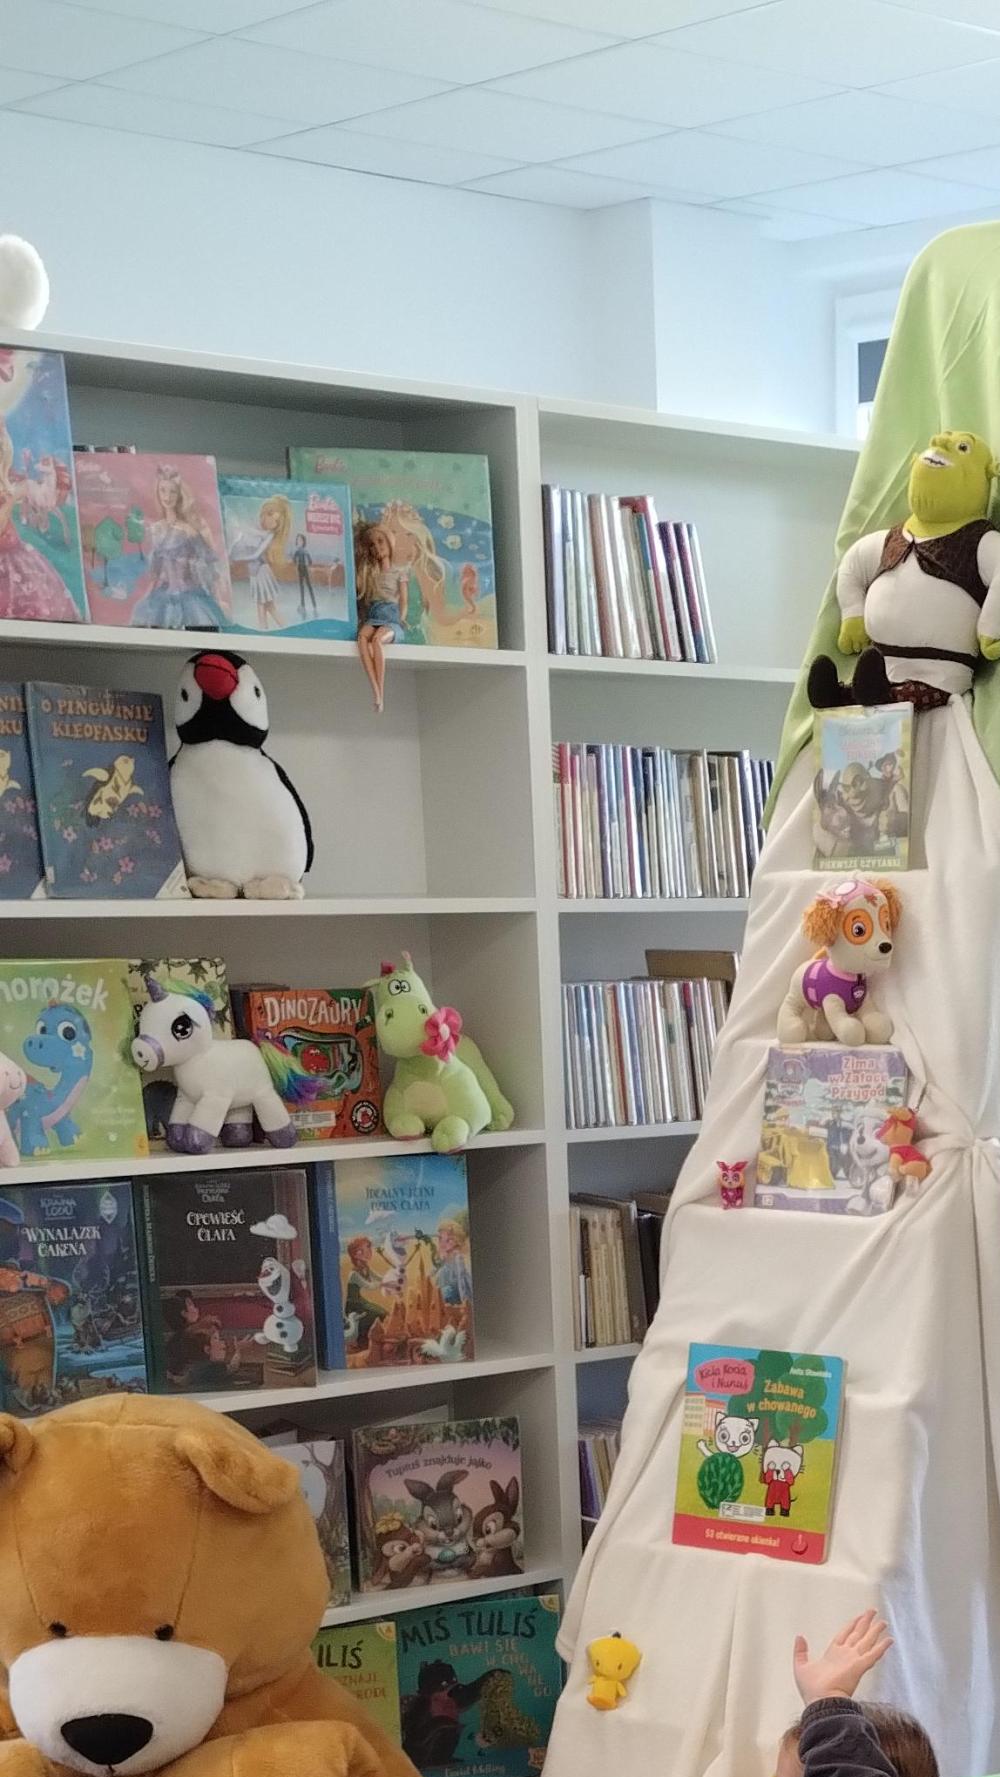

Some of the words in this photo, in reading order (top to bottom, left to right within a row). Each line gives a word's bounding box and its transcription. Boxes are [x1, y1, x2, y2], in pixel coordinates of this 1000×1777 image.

[41, 698, 52, 713] O
[58, 698, 153, 721] PINGWINIE
[52, 720, 149, 743] KLEOFASKU
[21, 1225, 102, 1242] WYNALAZEK
[764, 1379, 805, 1399] Zabawa
[758, 1398, 817, 1418] chowanego
[401, 1608, 450, 1653] MIŚ
[457, 1606, 538, 1639] TULIŚ
